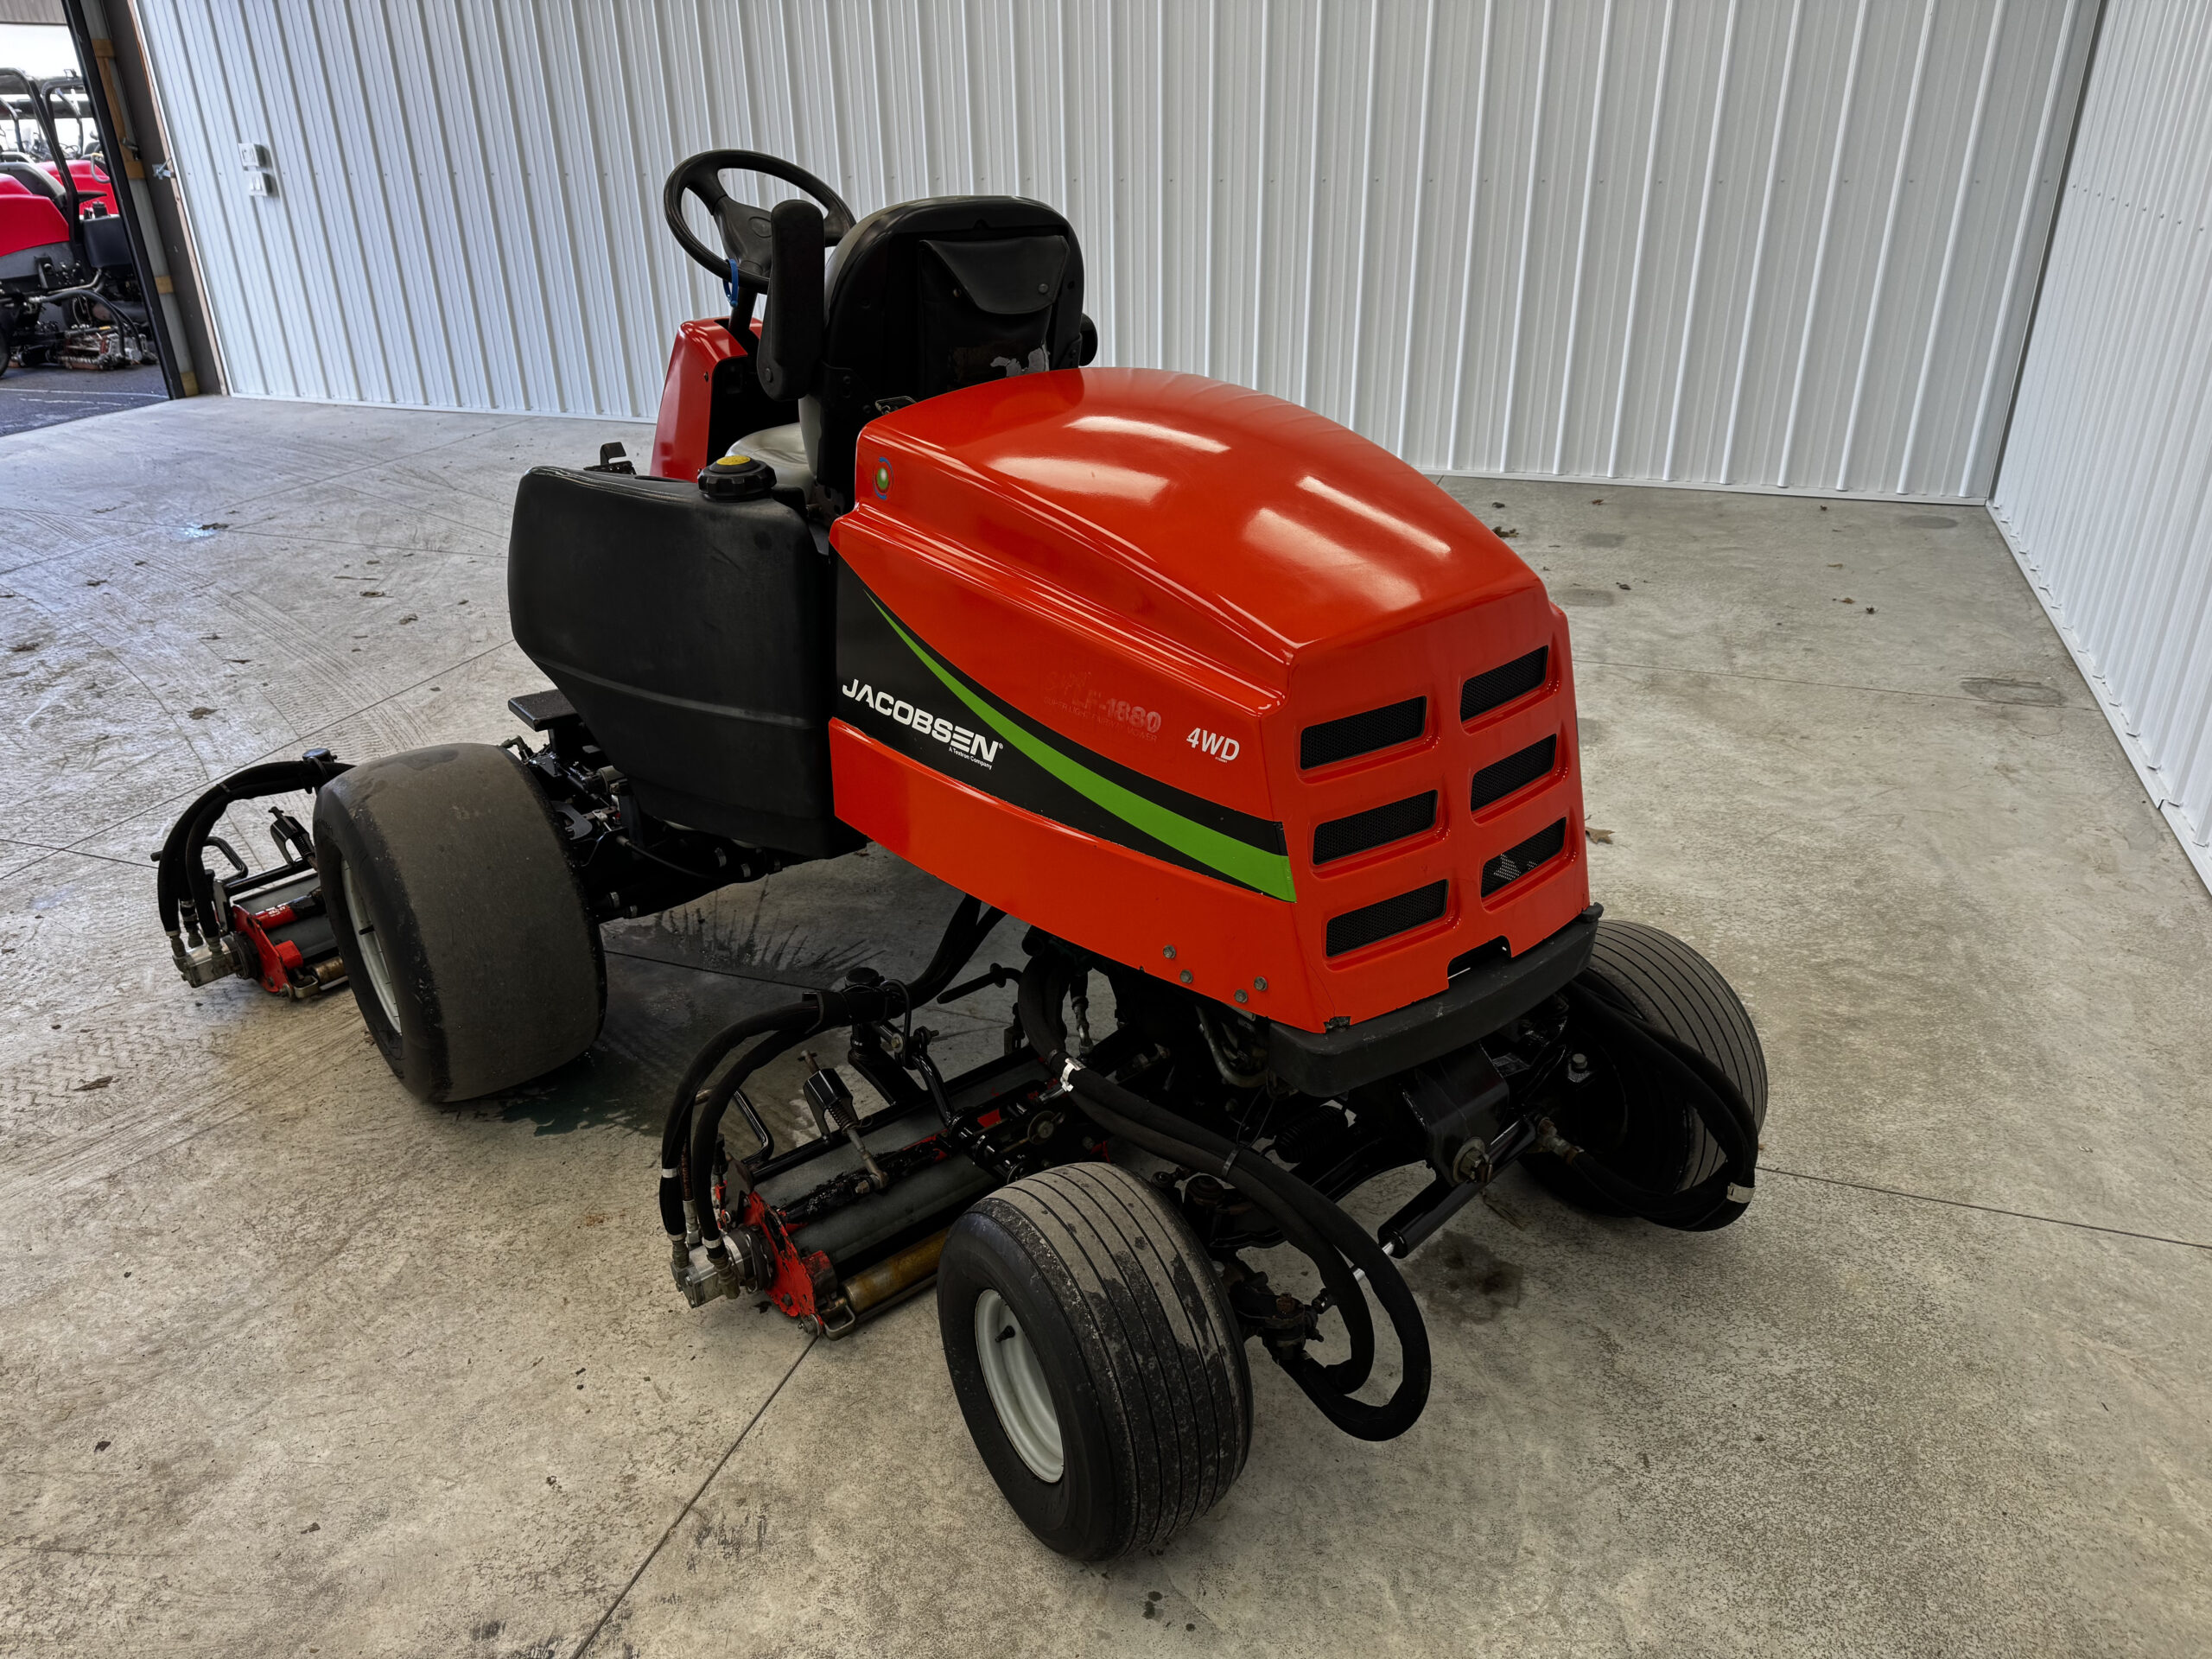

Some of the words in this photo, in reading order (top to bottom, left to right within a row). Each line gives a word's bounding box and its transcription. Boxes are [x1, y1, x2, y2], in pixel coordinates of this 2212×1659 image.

[842, 678, 999, 763] JACOBSEN
[952, 747, 970, 760] Textron
[969, 755, 993, 771] Company
[1186, 728, 1240, 761] 4WD
